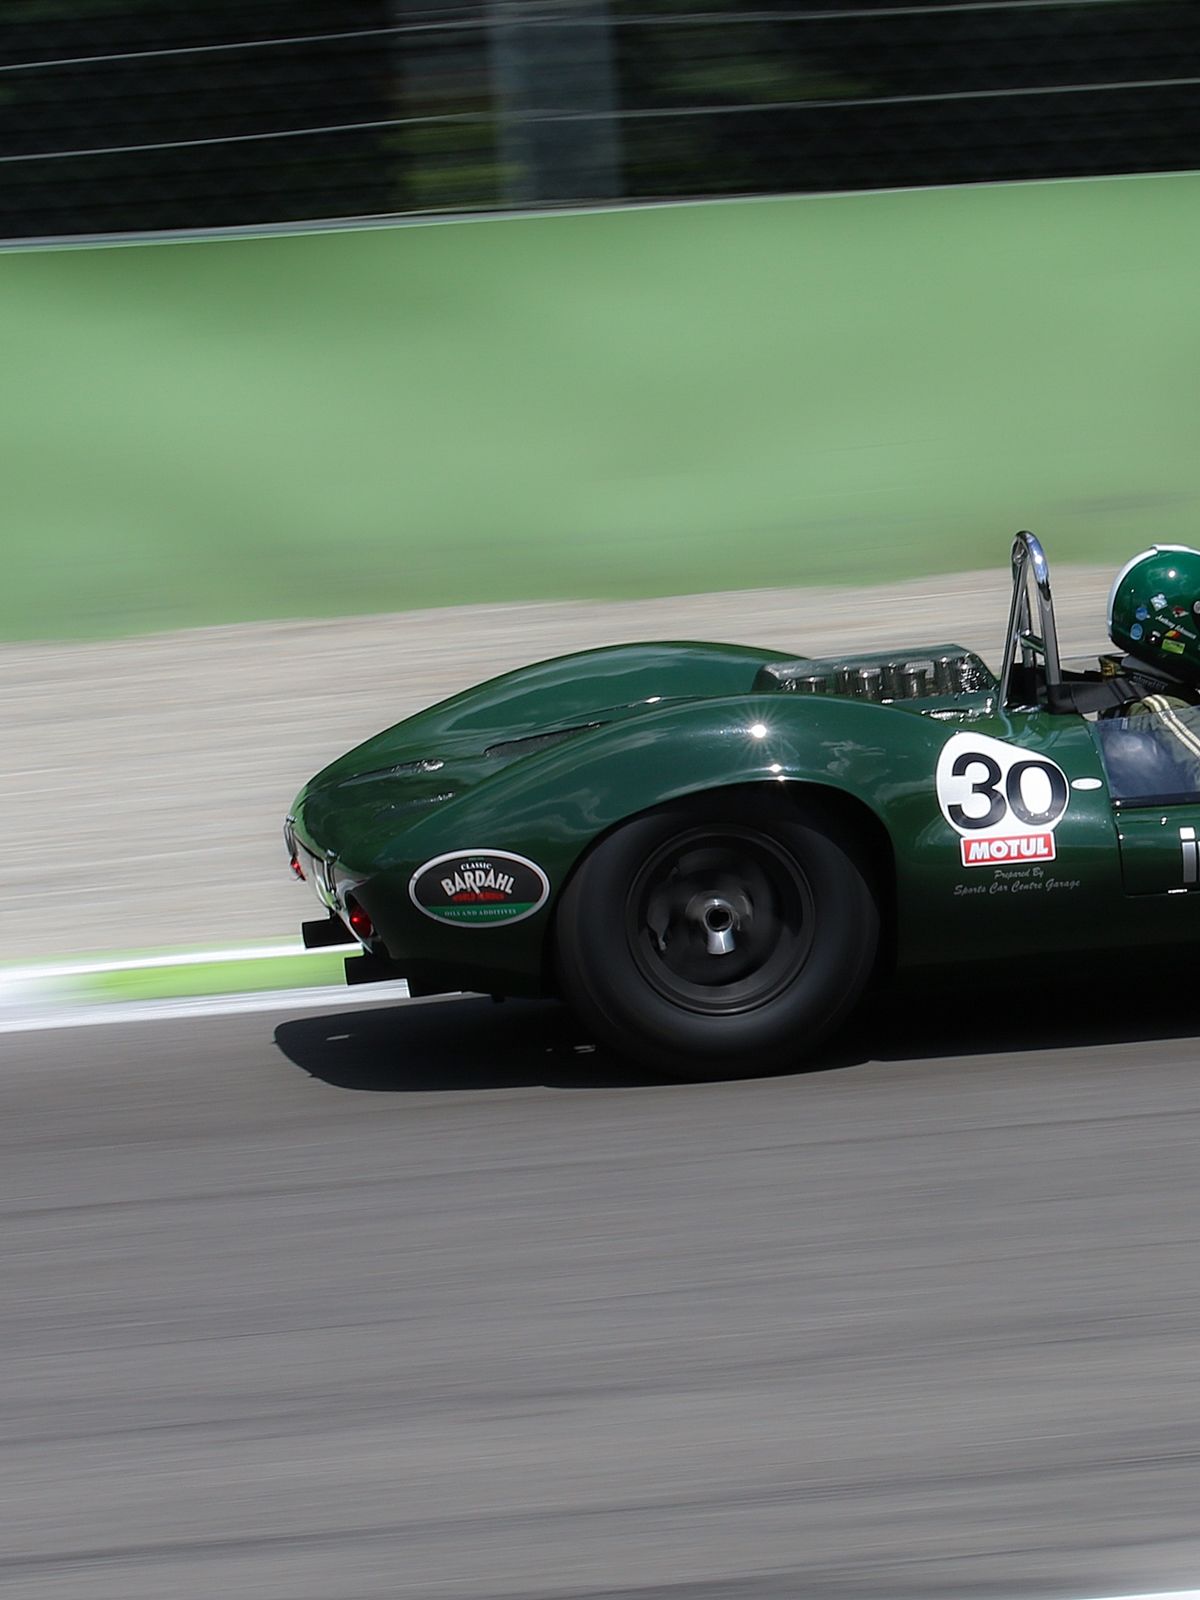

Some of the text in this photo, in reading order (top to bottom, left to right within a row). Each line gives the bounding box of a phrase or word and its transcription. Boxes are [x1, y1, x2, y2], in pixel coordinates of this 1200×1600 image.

[947, 752, 1067, 830] 30
[968, 837, 1049, 861] MOTUL
[461, 862, 492, 871] CLASSIC
[994, 867, 1044, 880] Prepared By
[441, 869, 515, 896] BARDAHL
[953, 878, 1080, 896] Sports Car Centre Garage
